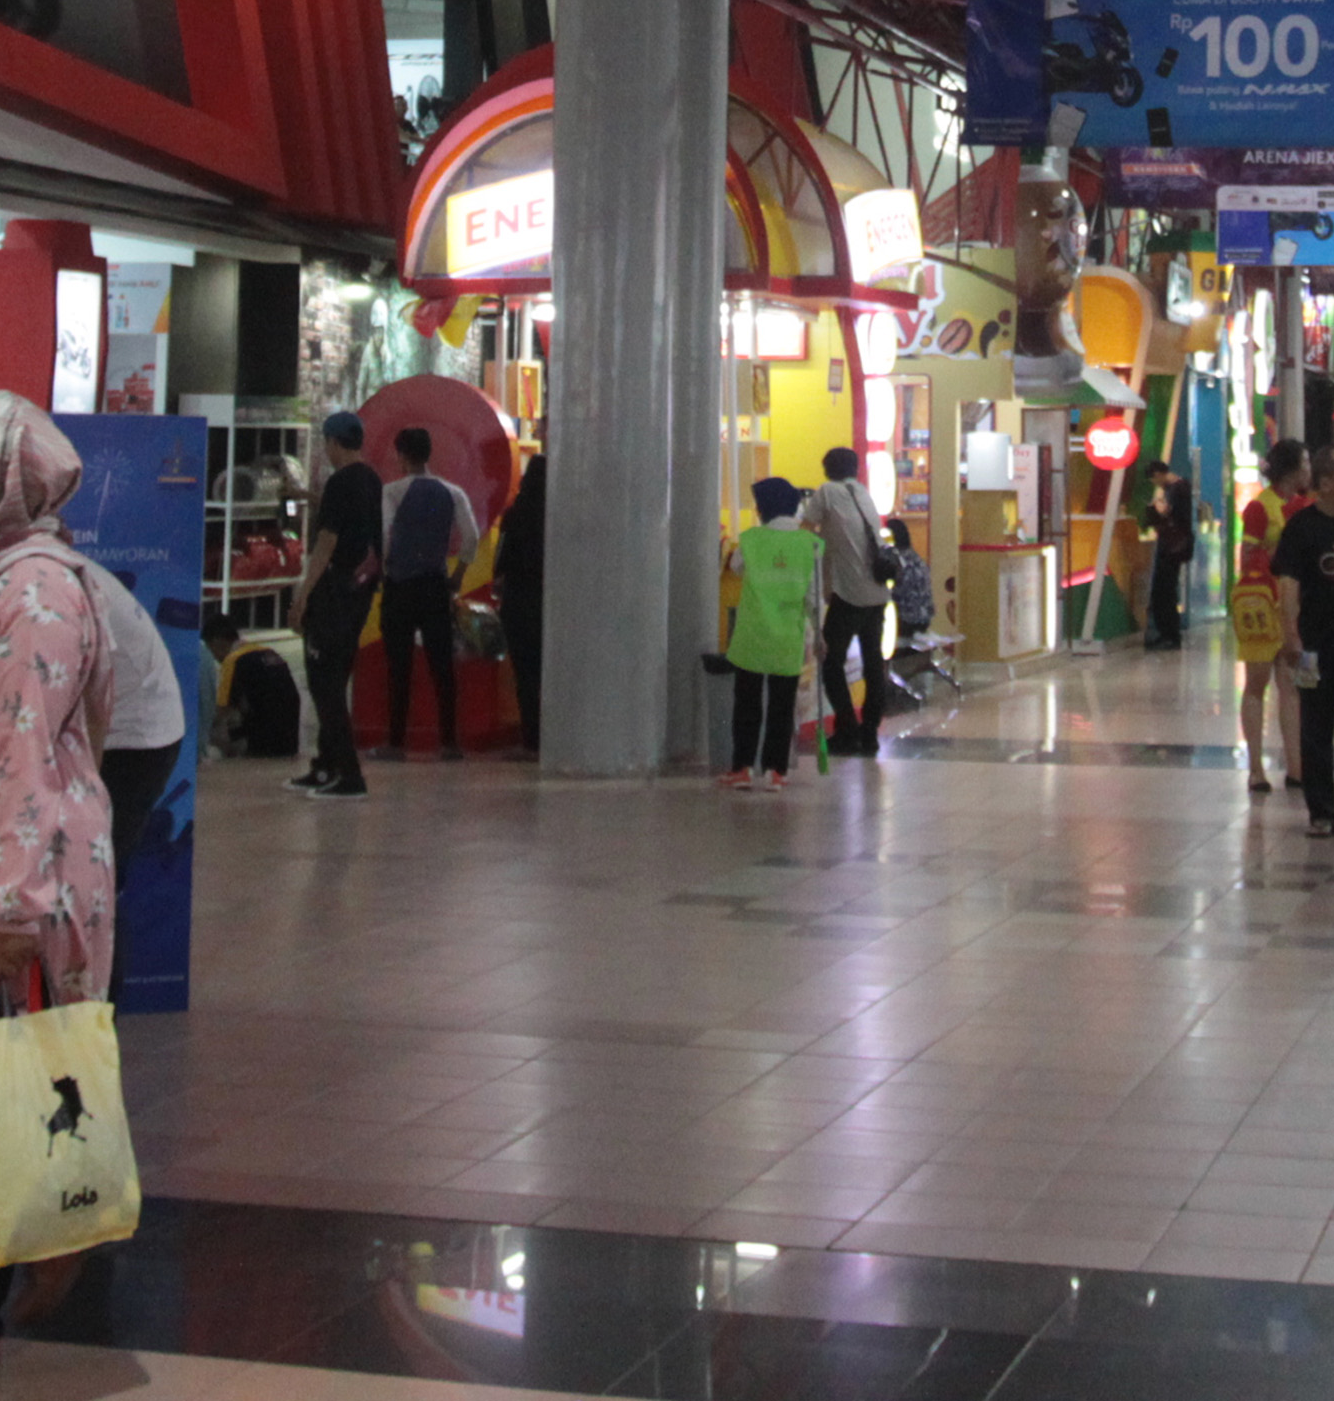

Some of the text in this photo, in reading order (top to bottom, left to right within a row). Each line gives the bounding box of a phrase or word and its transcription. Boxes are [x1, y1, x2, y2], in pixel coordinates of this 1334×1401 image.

[1170, 13, 1193, 33] Rp
[1189, 14, 1320, 78] 100
[1243, 150, 1300, 164] ARENA
